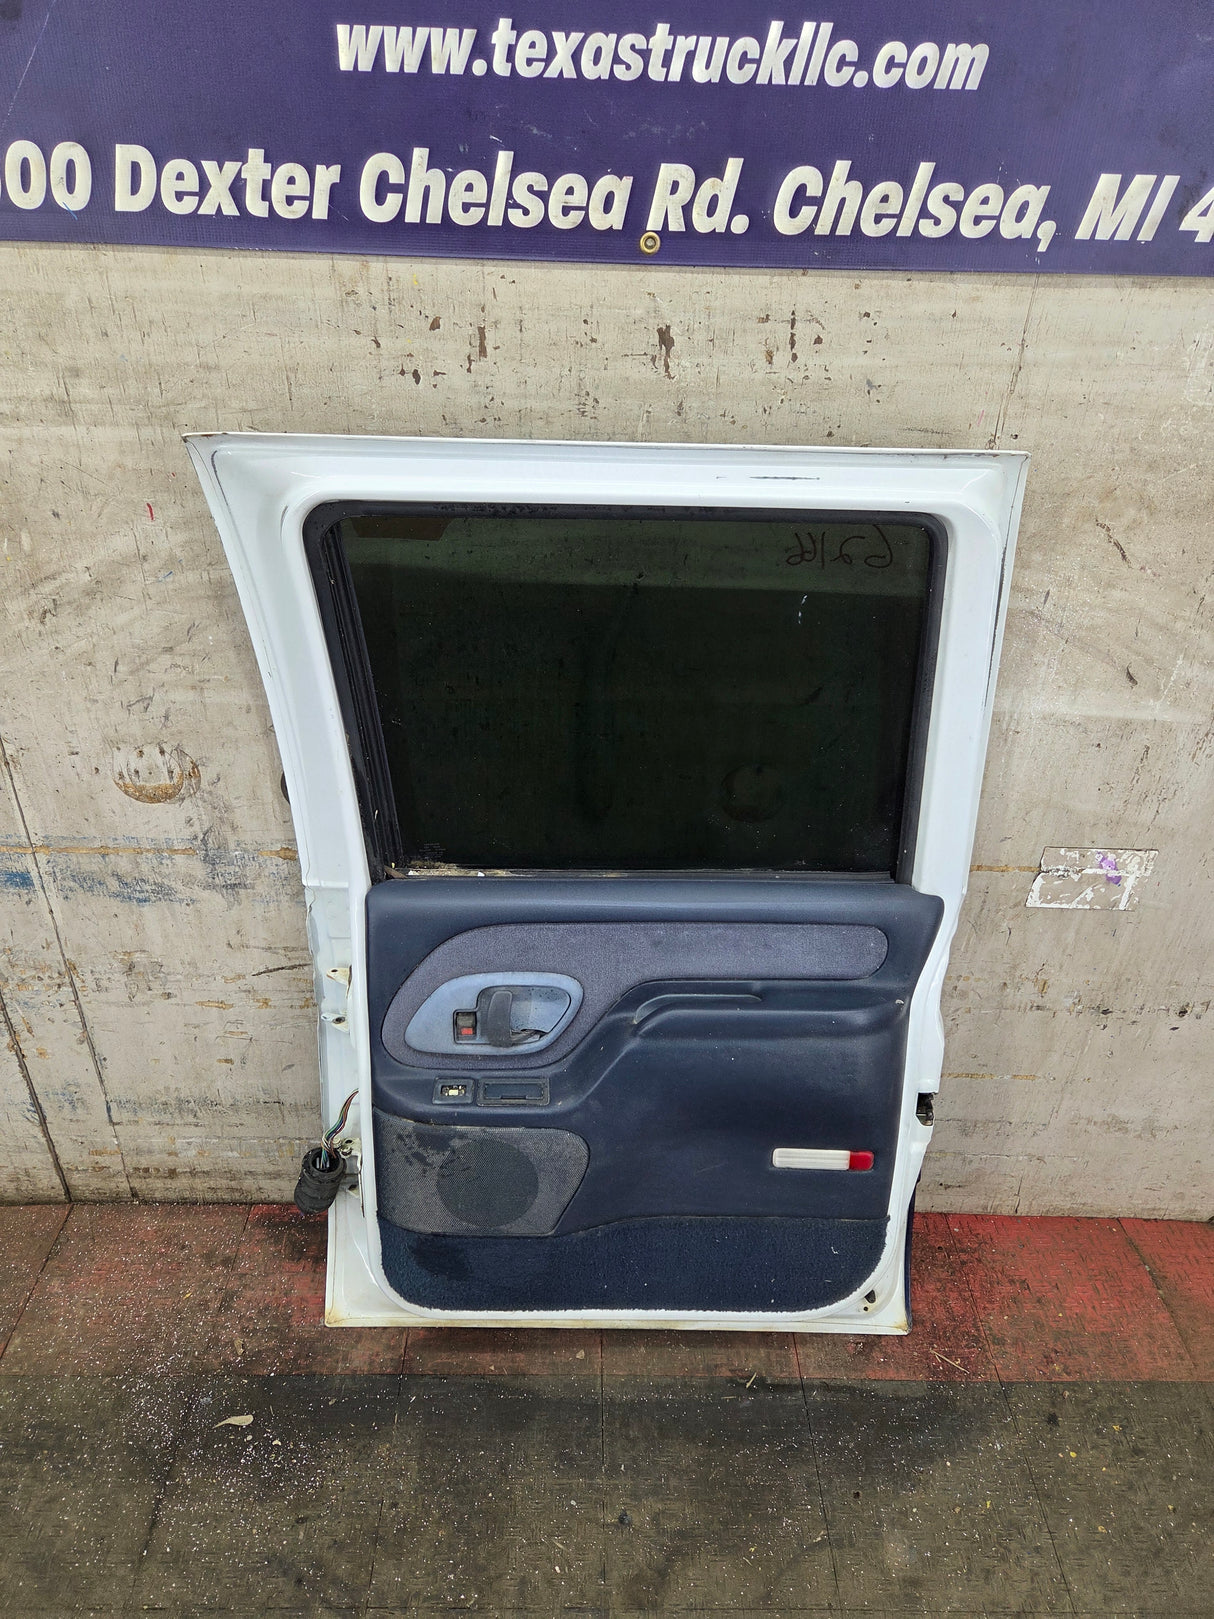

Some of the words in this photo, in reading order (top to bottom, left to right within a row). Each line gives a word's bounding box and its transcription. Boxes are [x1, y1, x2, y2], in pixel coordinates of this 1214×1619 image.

[336, 18, 990, 91] www.texastruckllc.com
[0, 140, 93, 212] 00
[114, 144, 342, 220] Dexter
[360, 147, 633, 230] Chelsea
[646, 158, 750, 235] Rd.
[773, 160, 1057, 252] Chelsea,
[1074, 173, 1181, 242] MI
